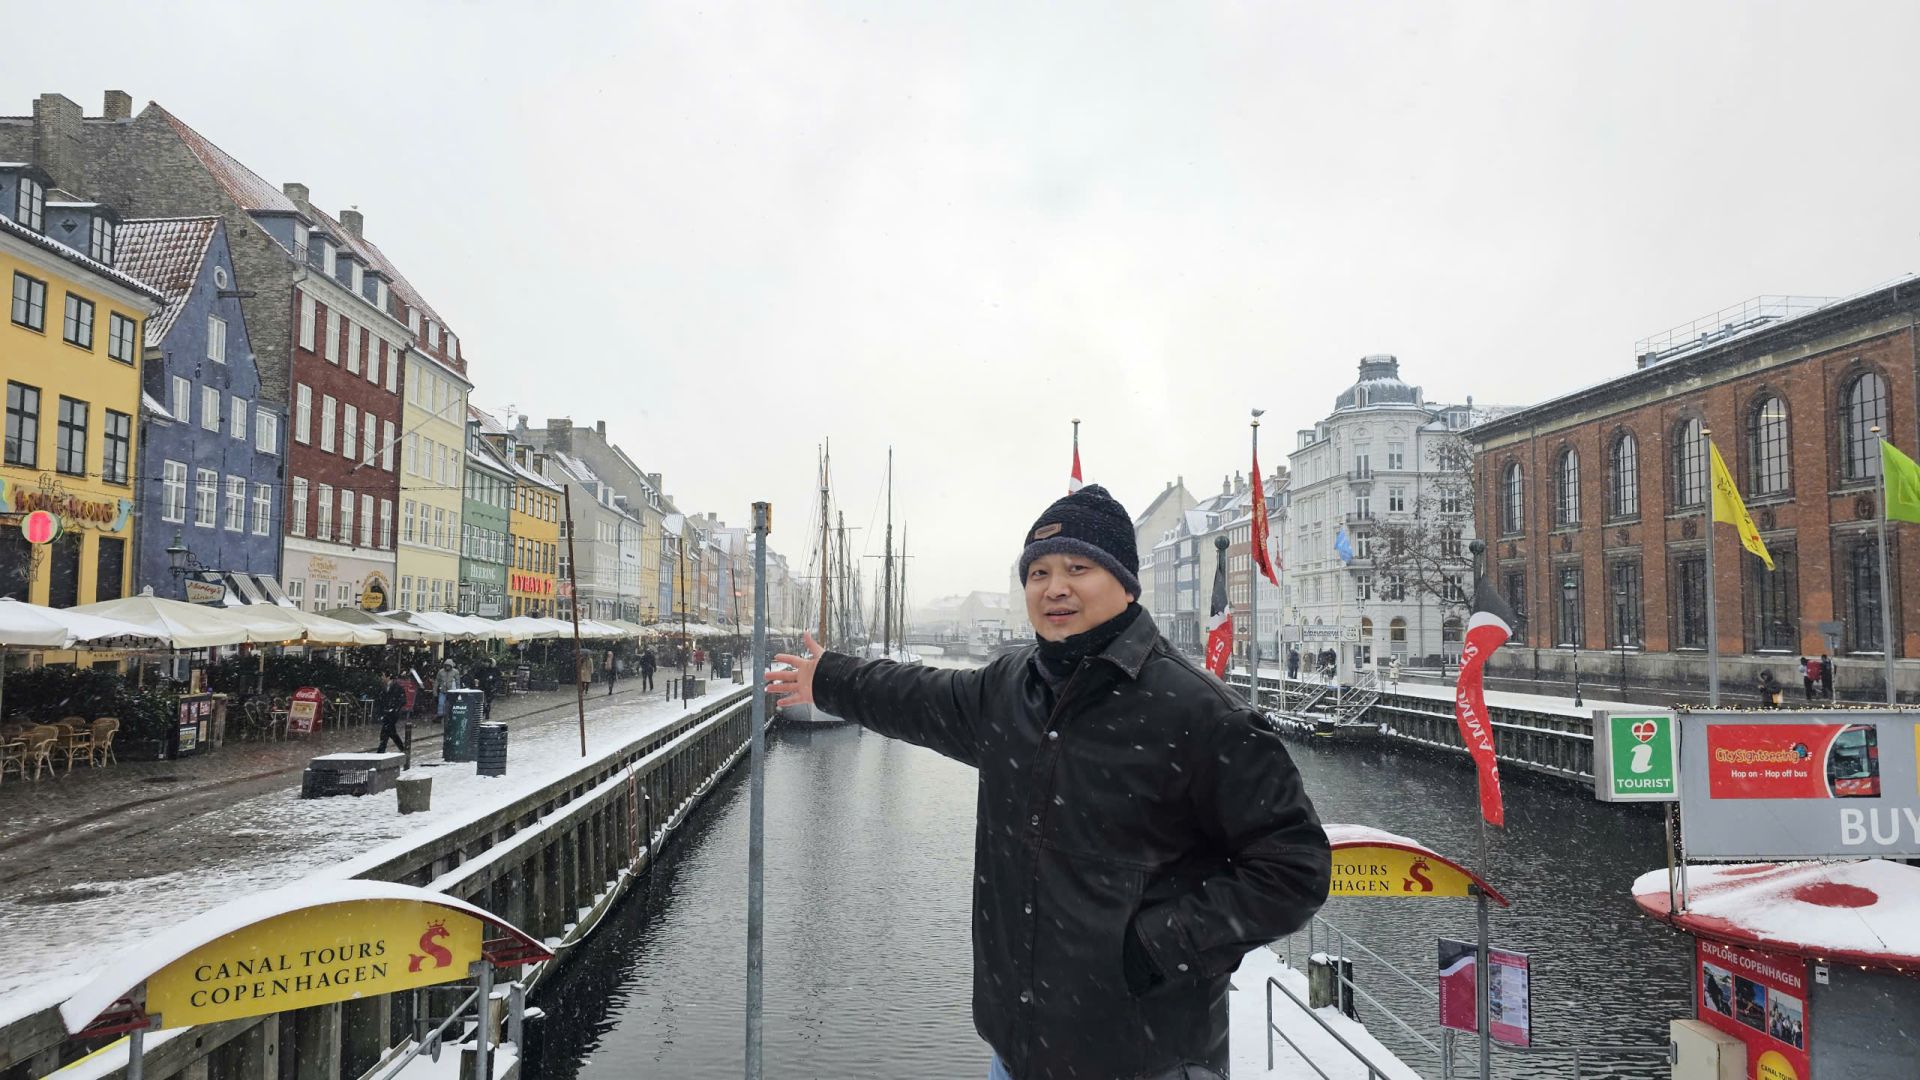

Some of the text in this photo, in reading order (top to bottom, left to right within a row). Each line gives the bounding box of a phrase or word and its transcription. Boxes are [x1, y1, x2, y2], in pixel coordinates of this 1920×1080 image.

[1715, 747, 1800, 764] CitySightseeing
[1731, 769, 1746, 778] Hop
[1764, 769, 1779, 778] Hop
[1781, 769, 1792, 777] off
[1793, 769, 1807, 777] bus
[1616, 778, 1671, 789] TOURIST
[1840, 807, 1920, 846] BUY
[1334, 864, 1387, 876] TOURS
[1332, 880, 1390, 892] HAGEN
[194, 939, 387, 983] CANAL TOURS
[1702, 941, 1801, 988] EXPLORE COPENHAGEN
[190, 962, 389, 1008] COPENHAGEN
[1760, 1064, 1778, 1077] CANAL
